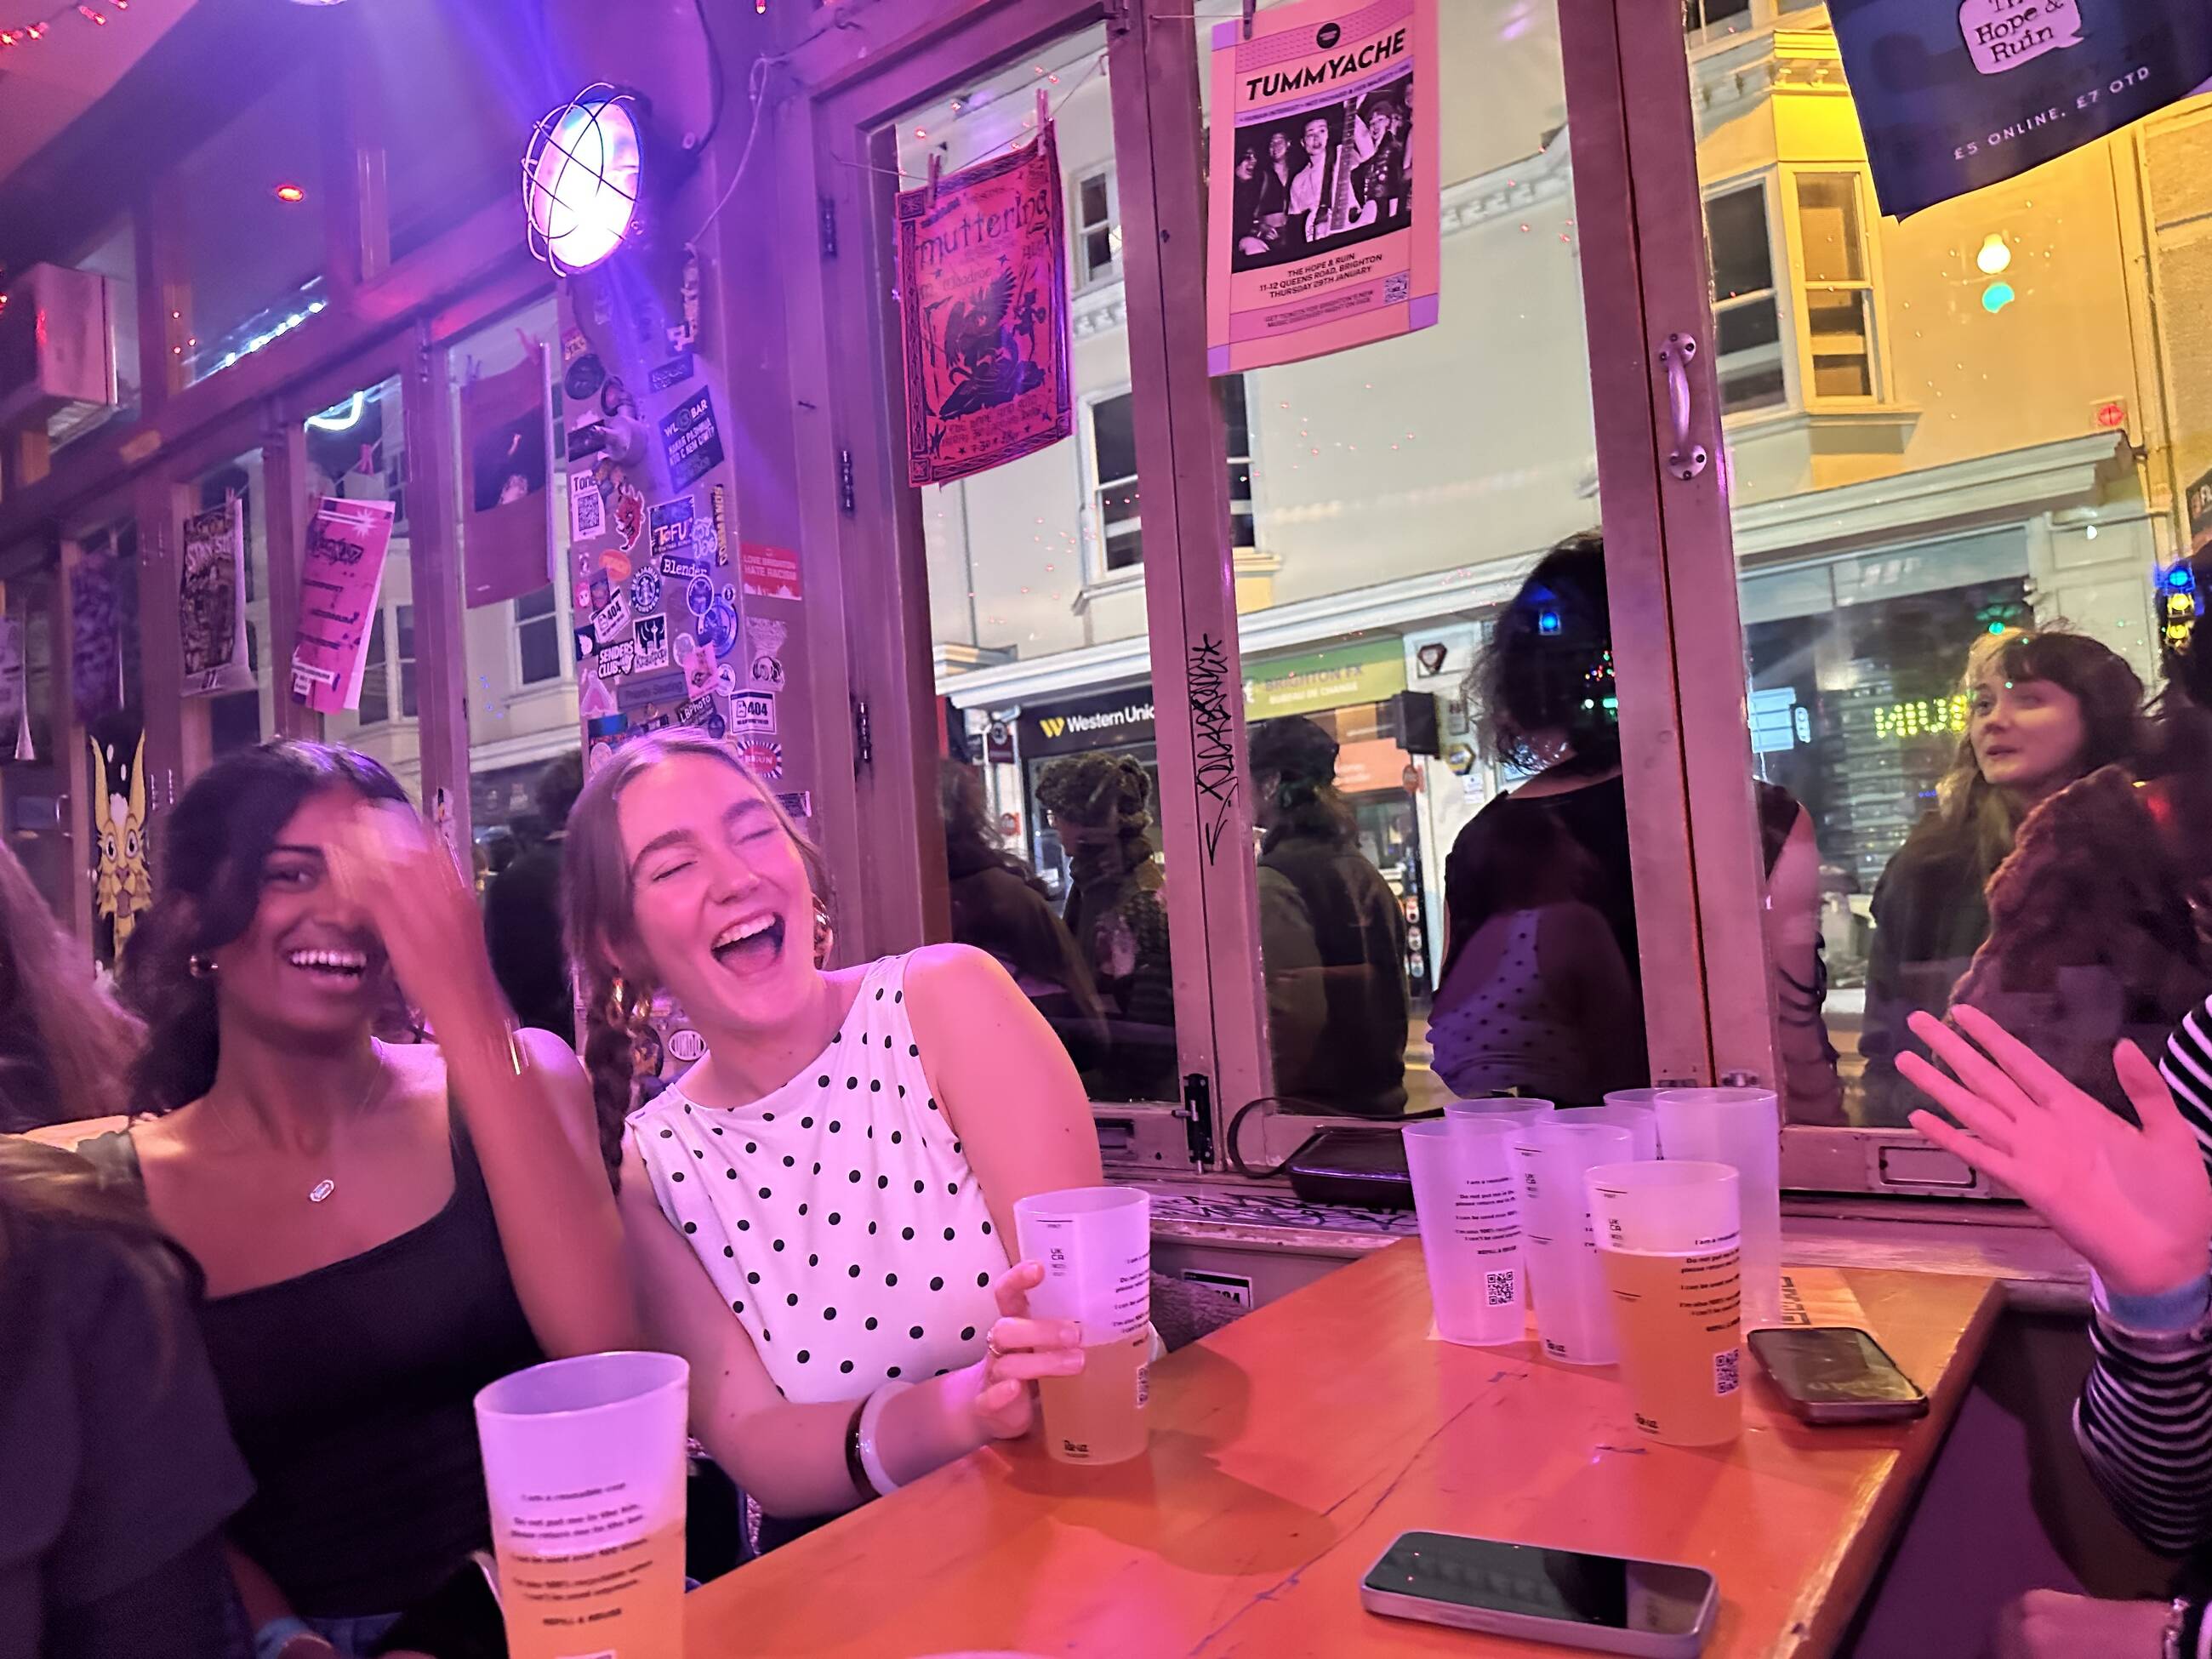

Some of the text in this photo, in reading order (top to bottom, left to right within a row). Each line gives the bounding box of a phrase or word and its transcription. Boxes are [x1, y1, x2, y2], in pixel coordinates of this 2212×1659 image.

[1974, 7, 2038, 45] Hope
[1989, 26, 2054, 63] Ruin
[1246, 28, 1405, 100] TUMMYACHE
[2109, 66, 2150, 94] OTD
[1280, 274, 1313, 288] QUEENS
[1339, 254, 1382, 272] BRIGHTON
[1287, 270, 1303, 278] THE
[1305, 263, 1326, 273] HOPE
[1336, 253, 1355, 264] RUIN
[1269, 283, 1311, 298] THURSDAY
[1335, 266, 1372, 282] JANUARY
[691, 399, 708, 419] BAR
[664, 558, 708, 577] Blender
[607, 601, 623, 620] 404
[599, 641, 635, 664] SENDERS
[747, 701, 767, 716] 404
[1066, 711, 1125, 733] Western
